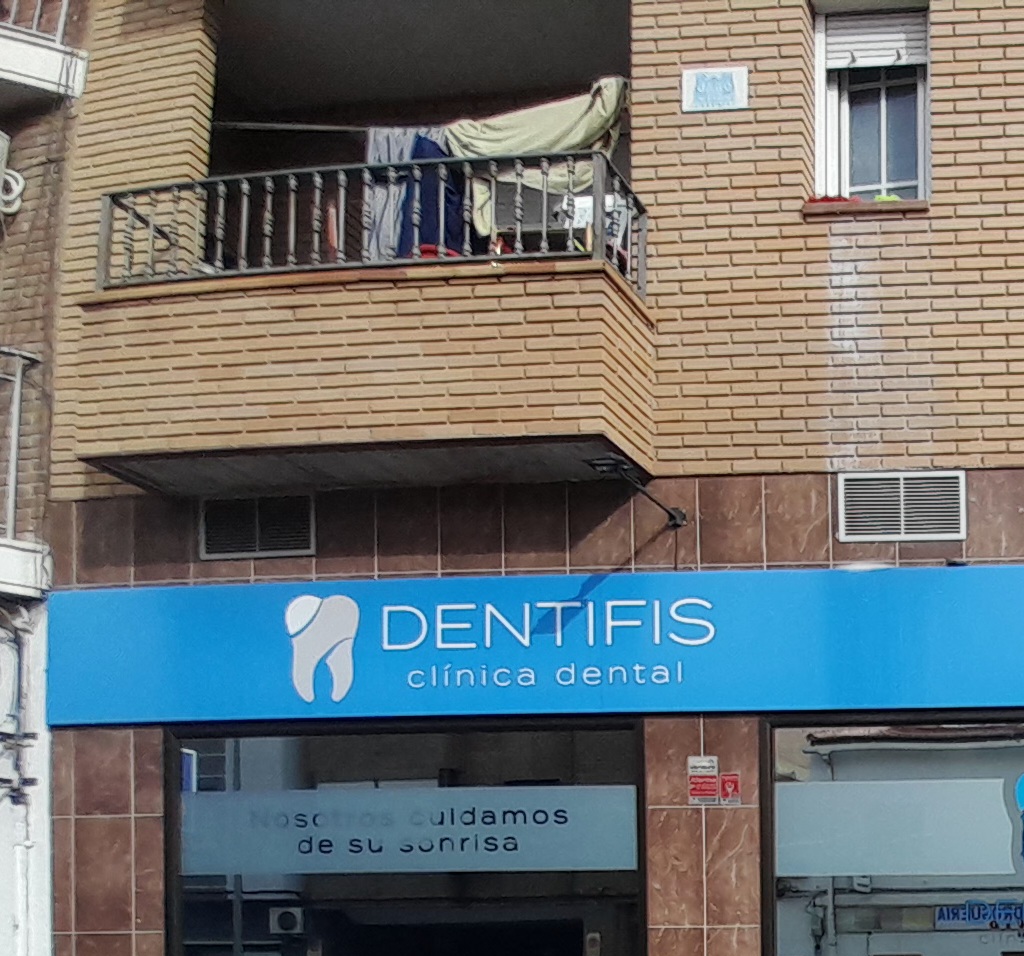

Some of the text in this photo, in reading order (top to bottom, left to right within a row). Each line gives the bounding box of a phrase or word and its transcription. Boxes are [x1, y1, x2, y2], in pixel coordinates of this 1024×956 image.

[381, 597, 716, 651] DENTIFIS
[406, 660, 684, 690] clínica dental
[297, 833, 519, 854] de su sonrisa
